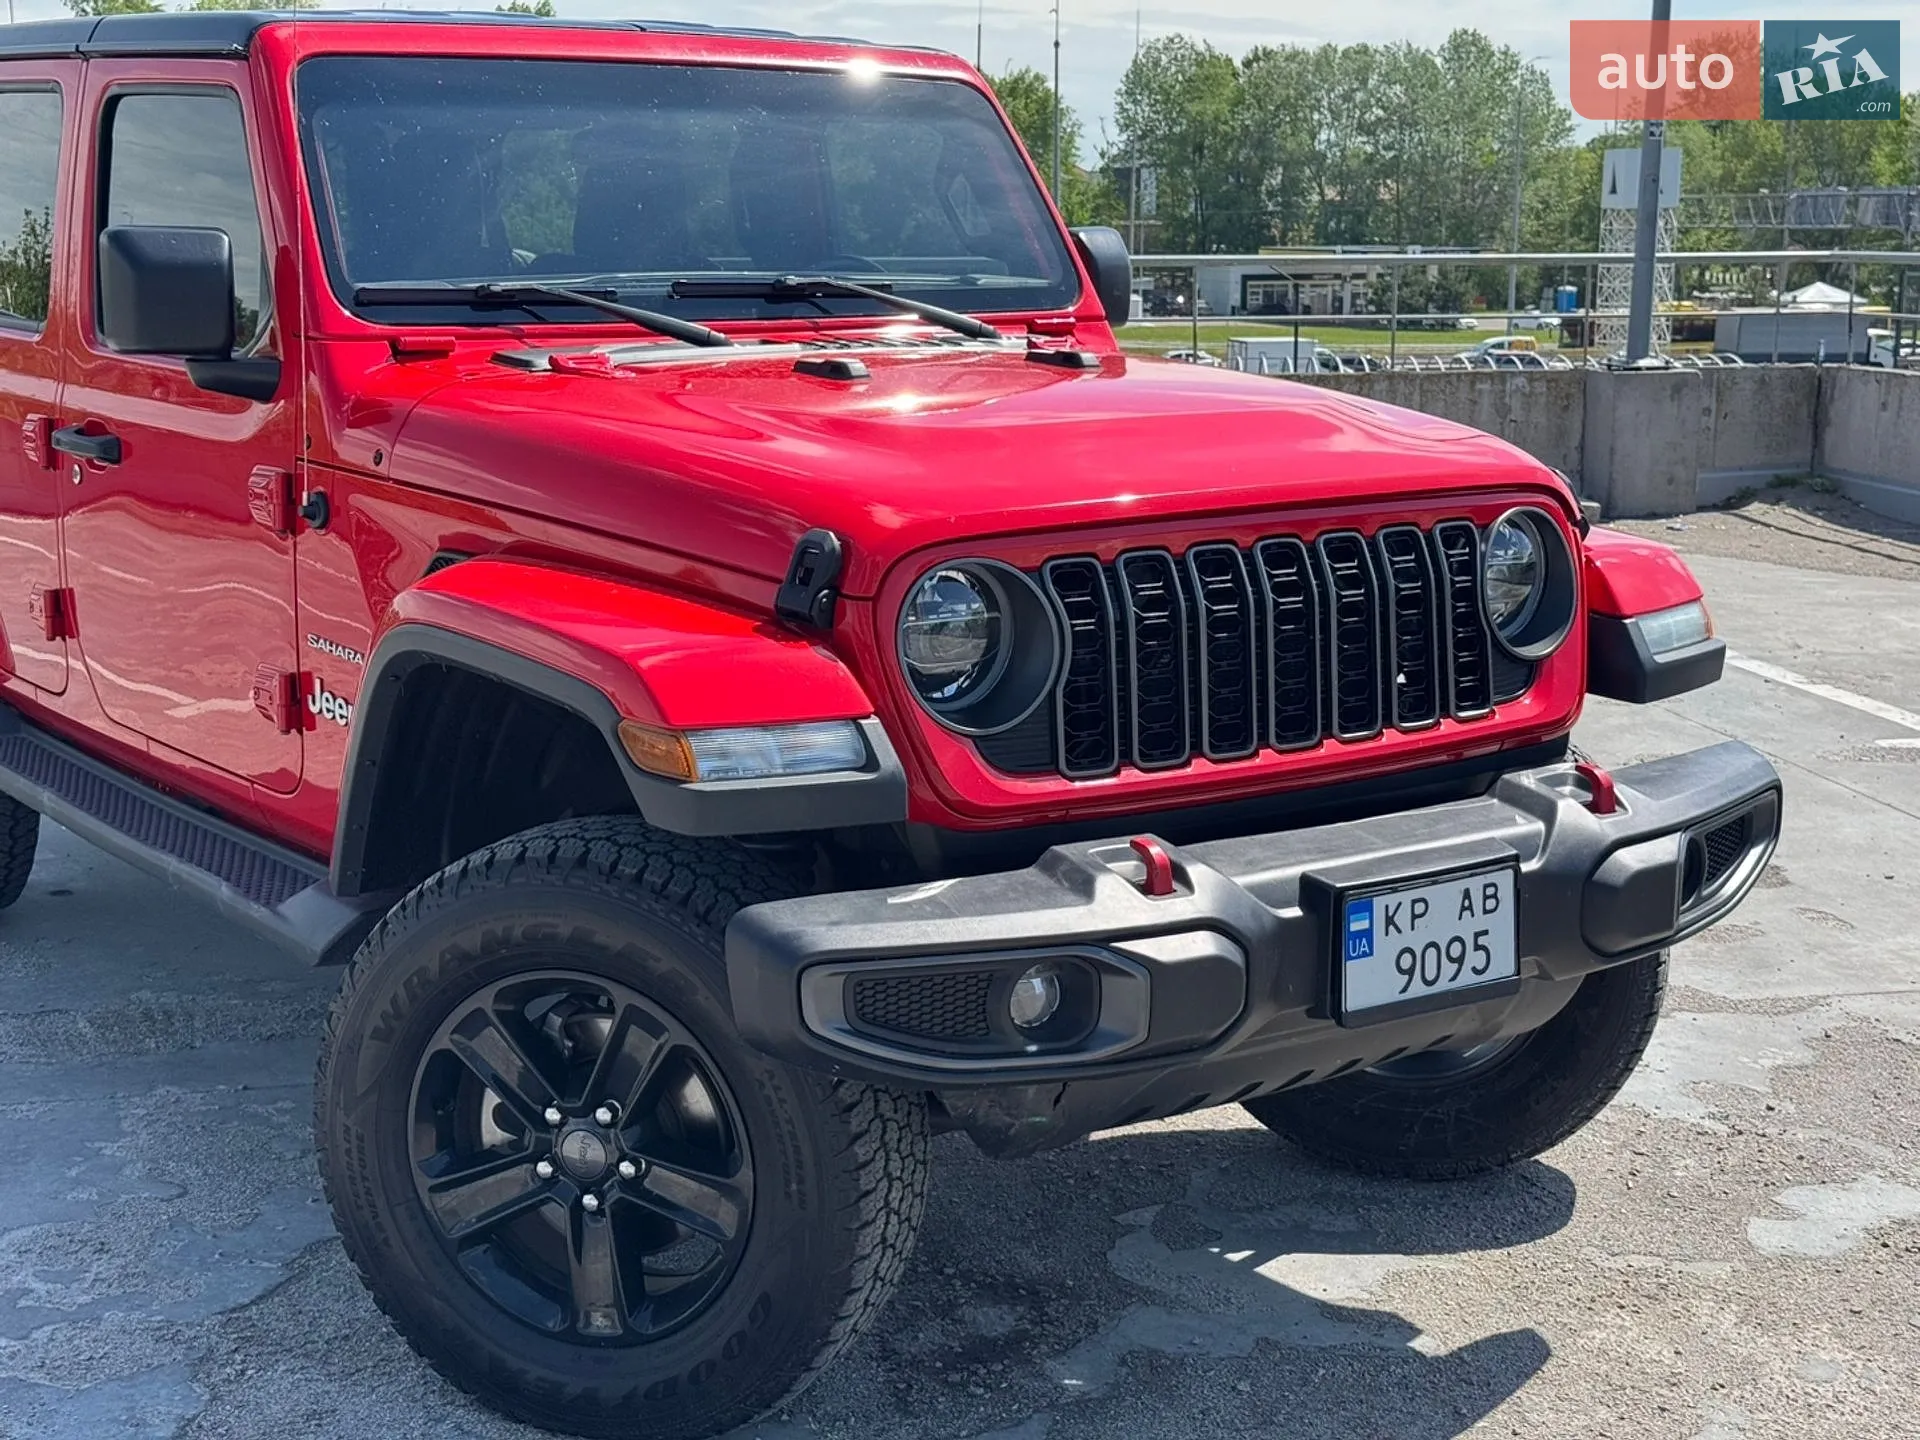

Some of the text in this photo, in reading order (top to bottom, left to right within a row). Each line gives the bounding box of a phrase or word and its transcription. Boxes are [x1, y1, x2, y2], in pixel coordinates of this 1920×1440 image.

[307, 633, 364, 666] SAHARA
[1384, 881, 1500, 937] KP AB
[1349, 937, 1370, 957] UA
[1394, 928, 1492, 995] 9095
[368, 921, 702, 1043] WRANGLER
